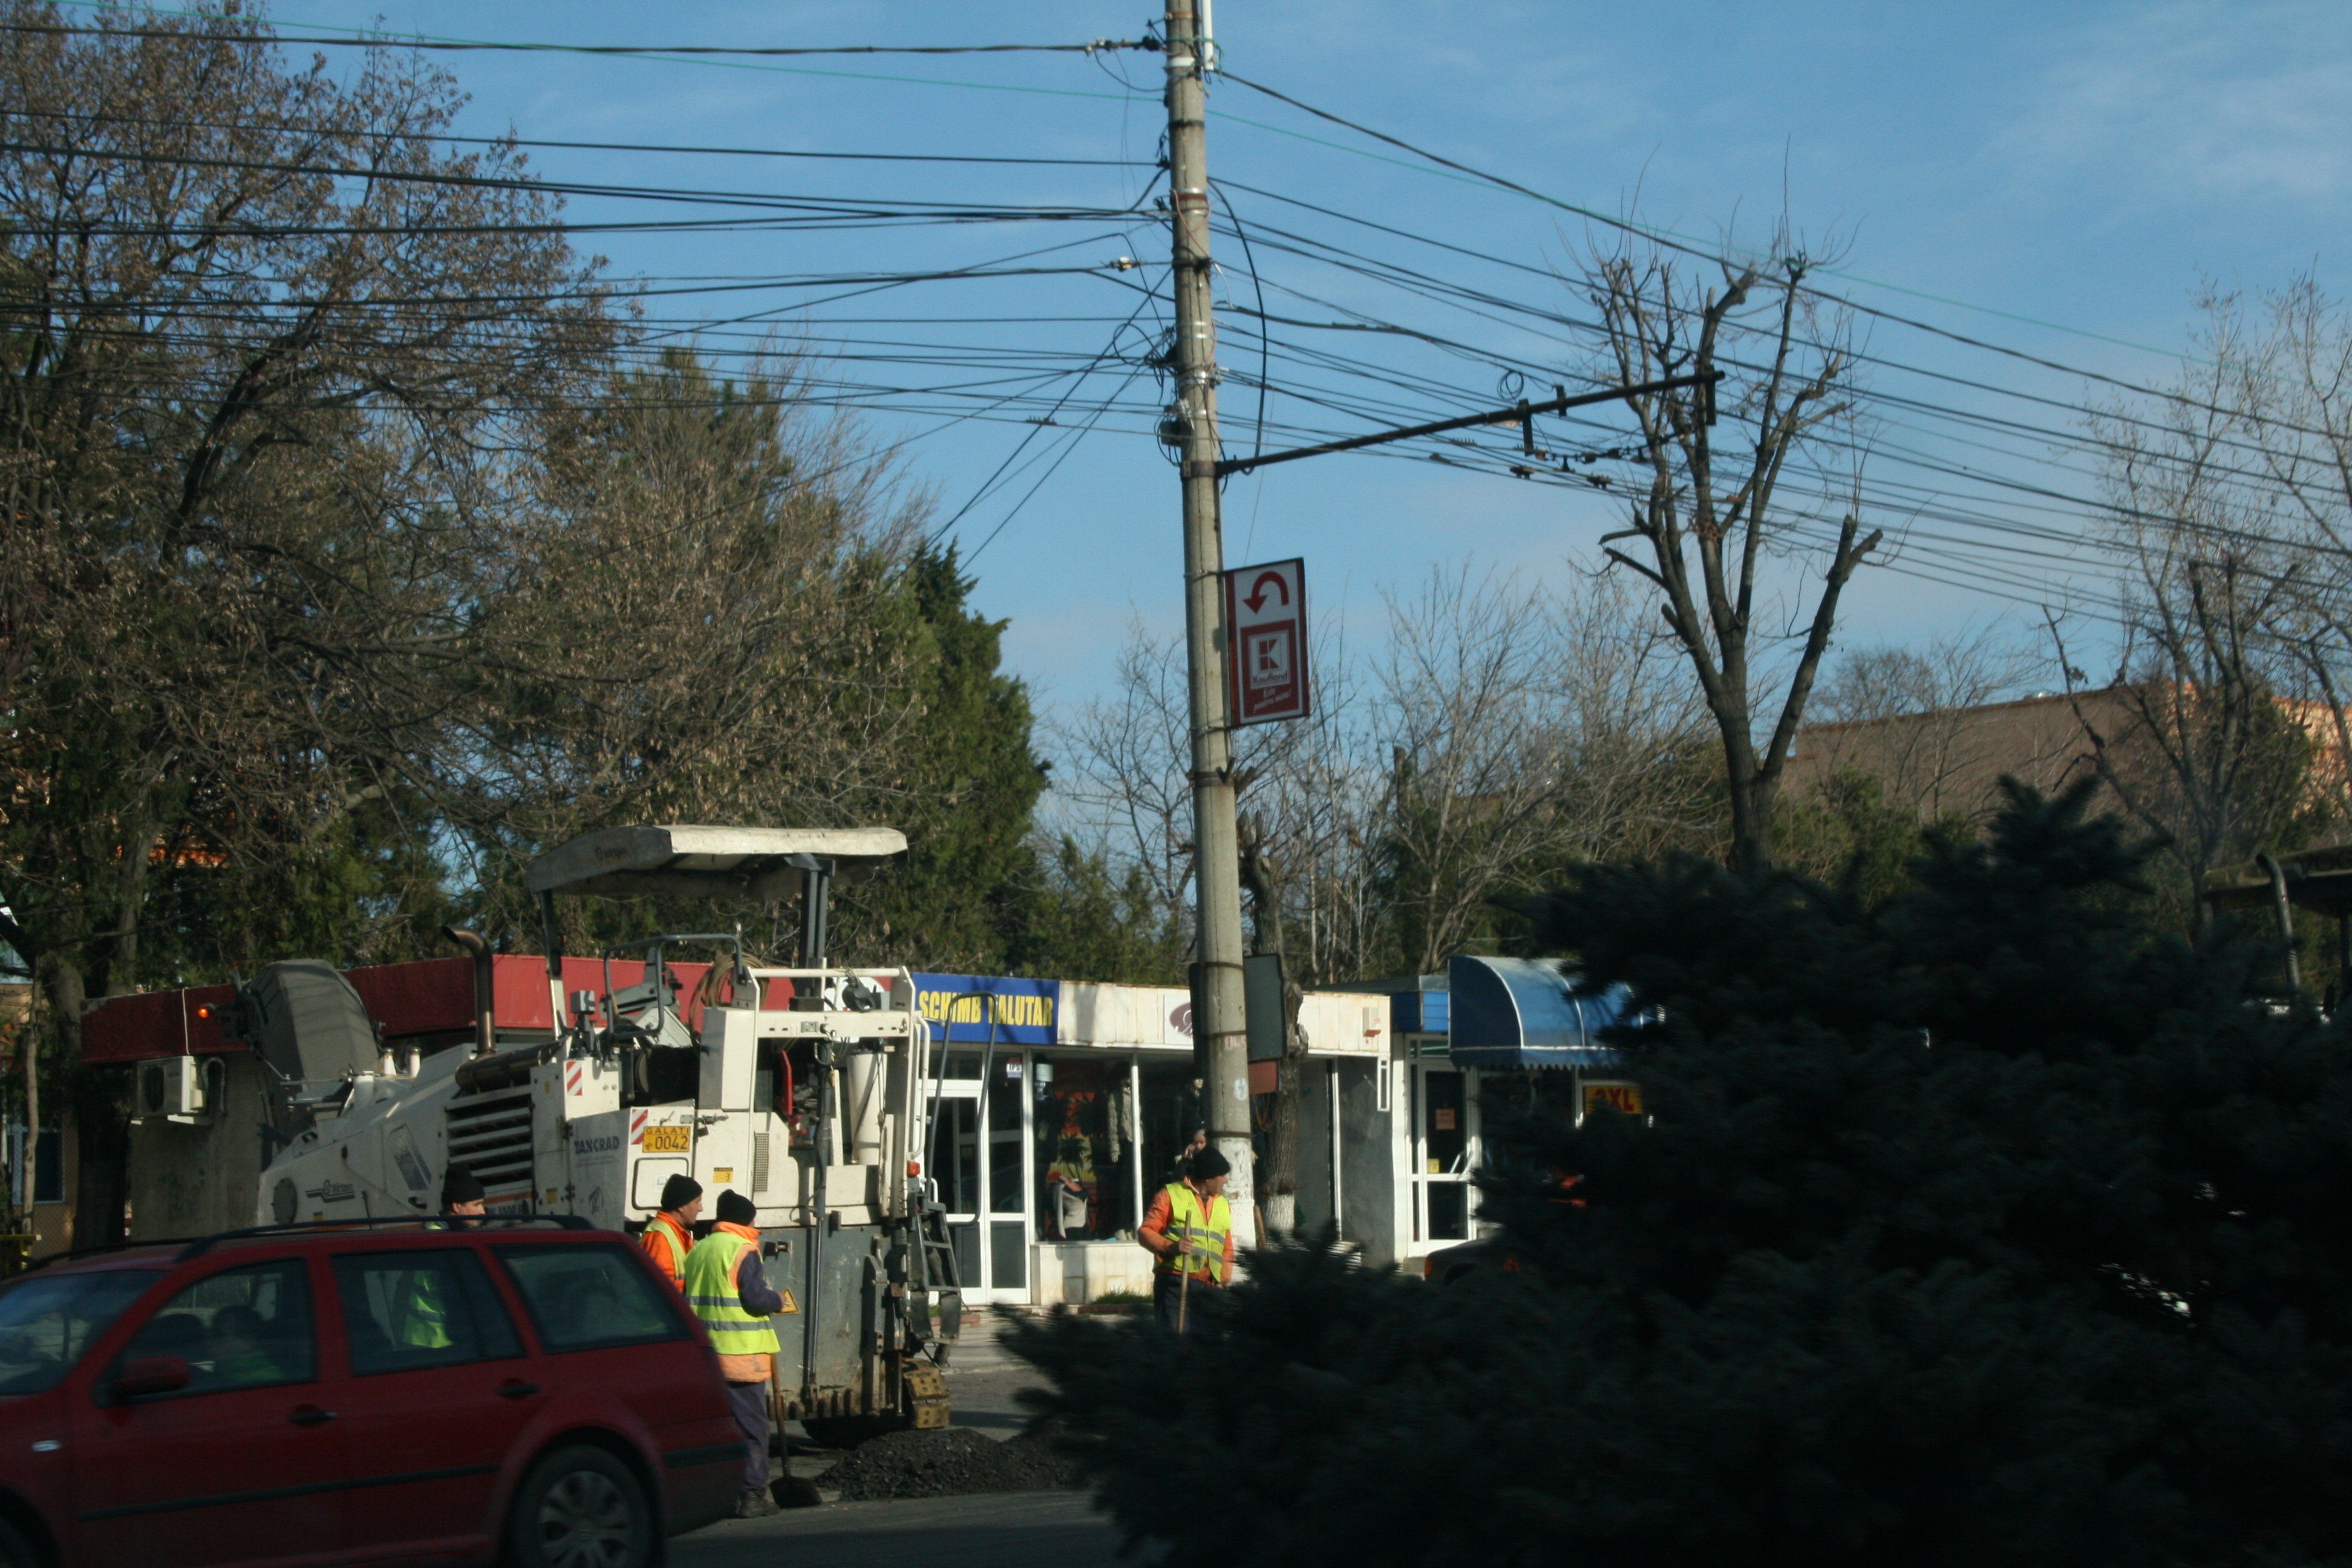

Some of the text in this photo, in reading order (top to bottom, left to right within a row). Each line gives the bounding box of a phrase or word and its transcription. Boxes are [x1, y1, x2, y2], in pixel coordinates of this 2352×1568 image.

[1253, 670, 1287, 685] Kaufland
[919, 990, 1053, 1027] SCHIMB VALUTAR
[574, 1135, 619, 1154] TANCRAD
[655, 1135, 688, 1150] 0042
